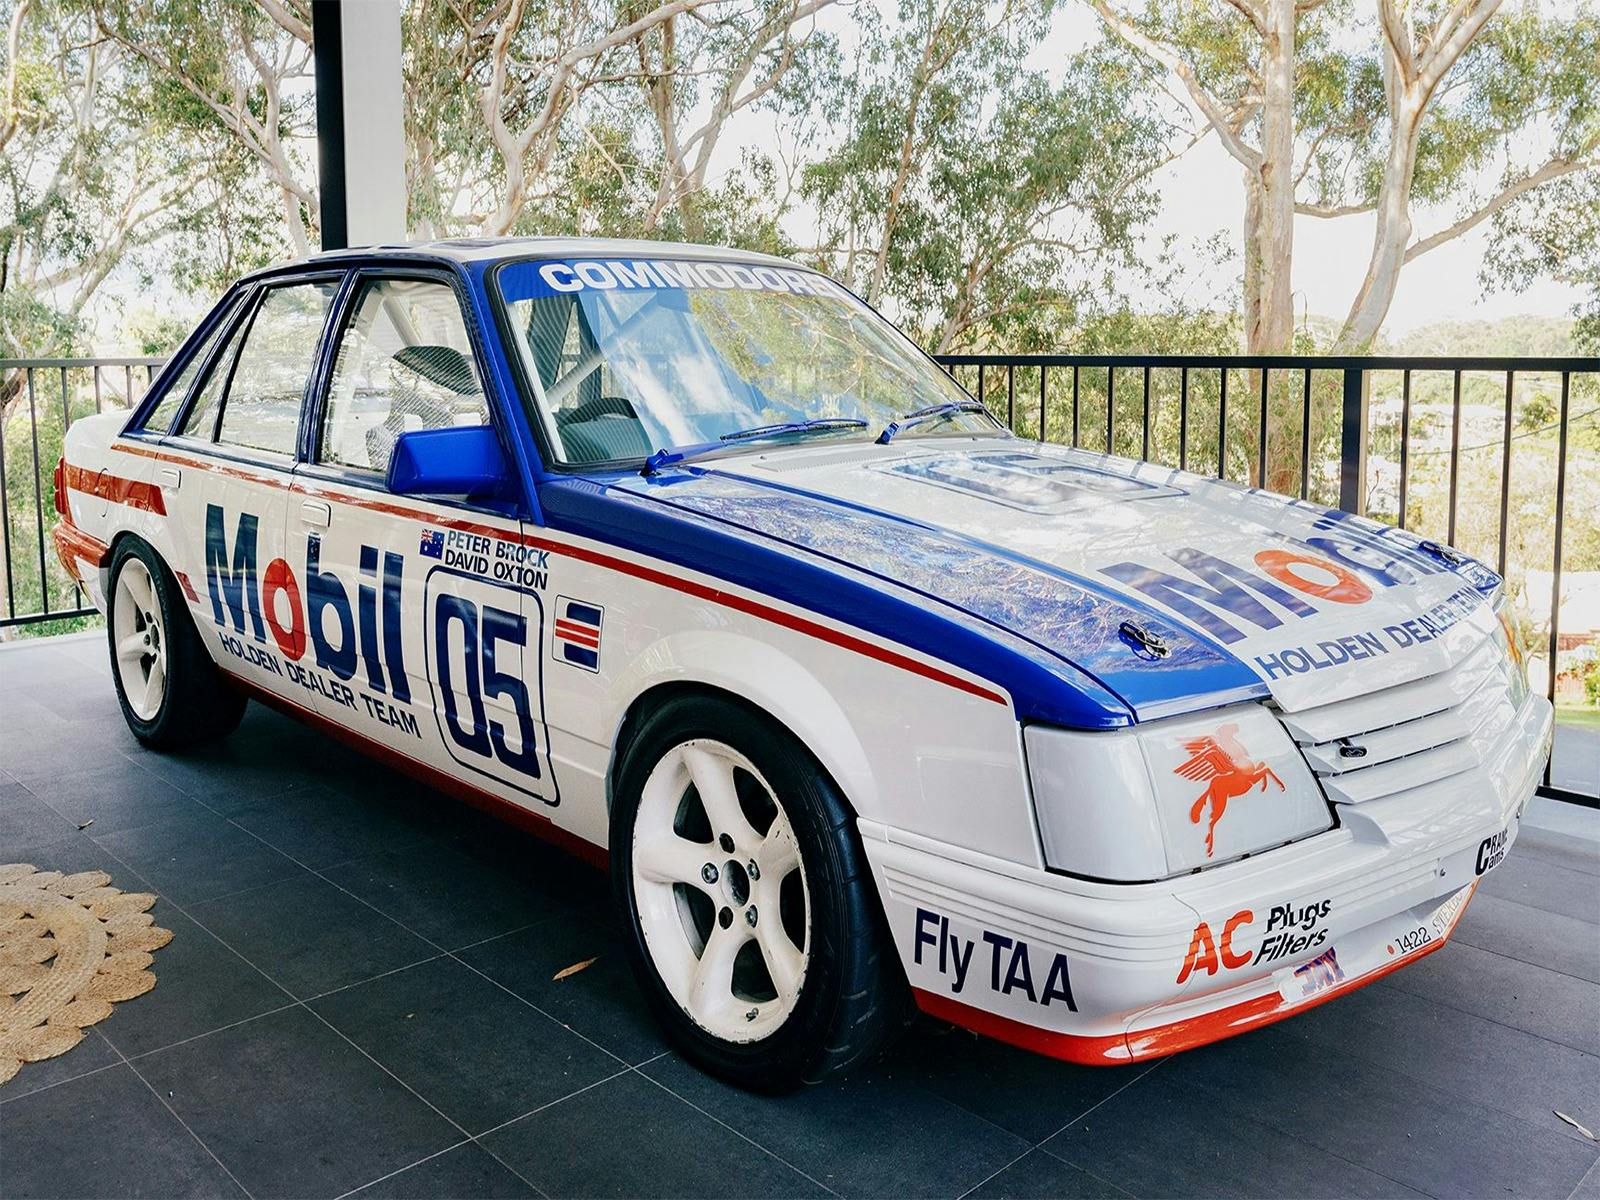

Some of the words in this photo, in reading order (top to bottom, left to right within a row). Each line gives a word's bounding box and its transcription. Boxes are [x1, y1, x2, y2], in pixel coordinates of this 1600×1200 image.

[539, 261, 841, 298] COMMODORE
[445, 549, 489, 575] DAVID
[493, 561, 548, 590] OXTON
[447, 530, 491, 556] PETER
[495, 541, 550, 569] BROCK
[206, 503, 412, 705] Mobil
[1254, 631, 1390, 681] HOLDEN
[1383, 603, 1462, 649] DEALER
[218, 631, 283, 676] HOLDEN
[285, 662, 358, 711] DEALER
[359, 692, 422, 739] TEAM
[435, 593, 541, 779] 05
[1264, 899, 1332, 934] Plugs
[1395, 926, 1432, 955] 1422
[914, 907, 975, 994] Fly
[983, 930, 1078, 1013] TAA
[1176, 909, 1254, 984] AC
[1252, 928, 1328, 966] Filters
